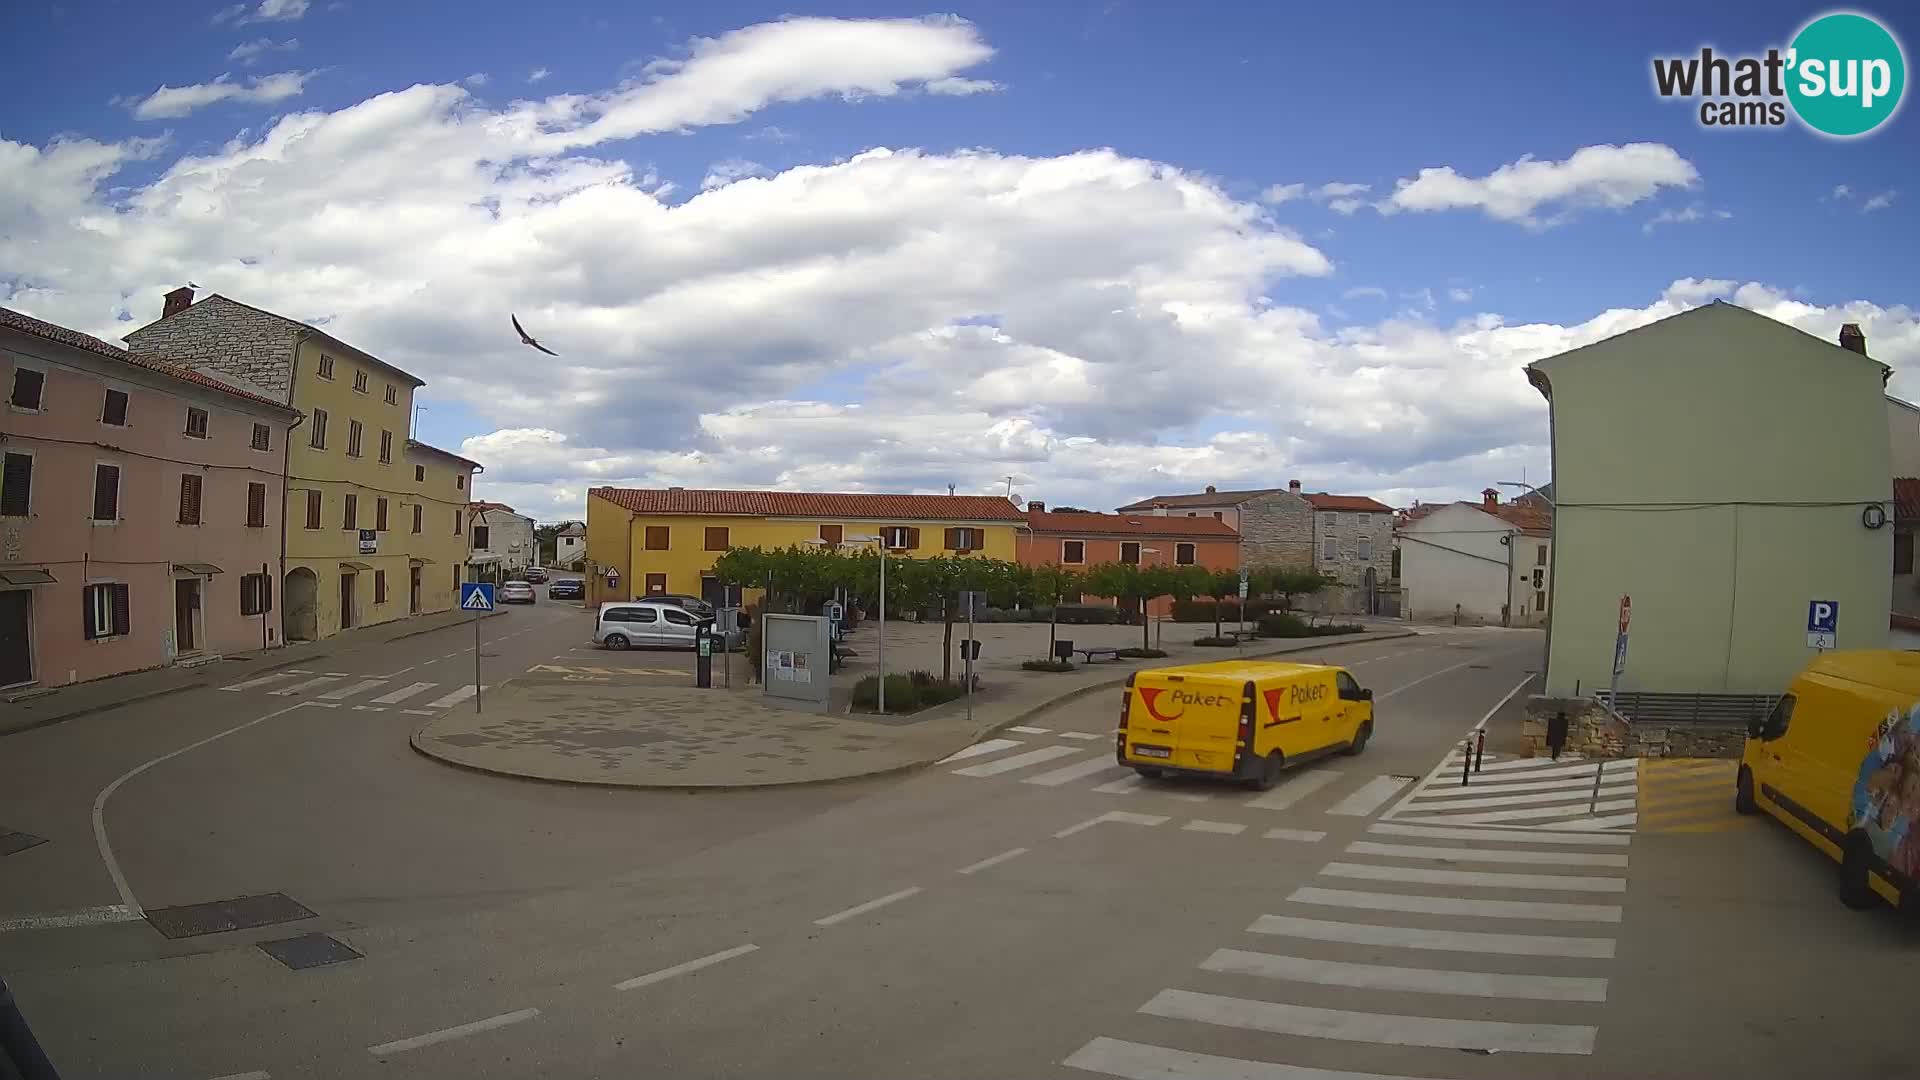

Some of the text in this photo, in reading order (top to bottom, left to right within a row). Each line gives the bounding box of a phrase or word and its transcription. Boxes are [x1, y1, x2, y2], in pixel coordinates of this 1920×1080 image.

[1814, 603, 1832, 626] P
[1171, 689, 1231, 707] Paket
[1290, 683, 1327, 705] Paket
